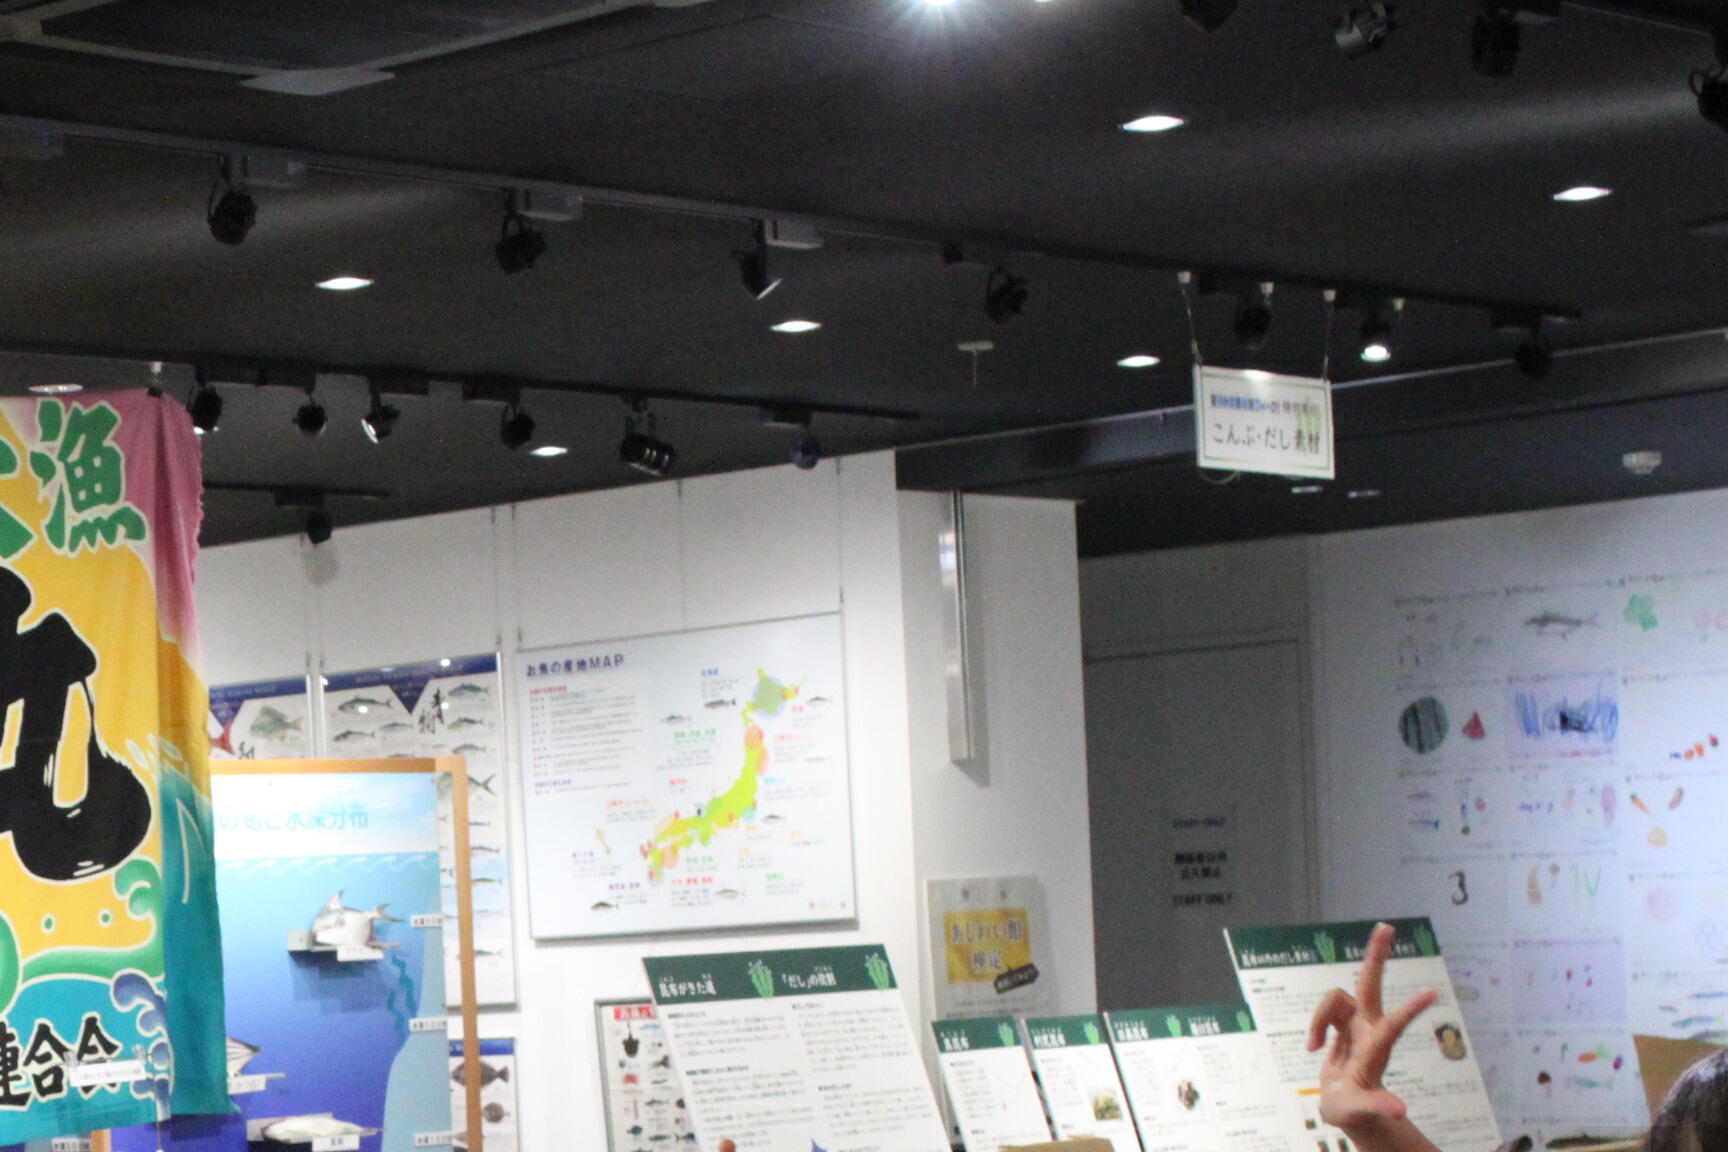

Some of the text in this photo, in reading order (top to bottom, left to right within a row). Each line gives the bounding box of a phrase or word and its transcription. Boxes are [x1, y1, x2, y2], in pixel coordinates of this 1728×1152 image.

[527, 653, 624, 677] お魚の産地MAP
